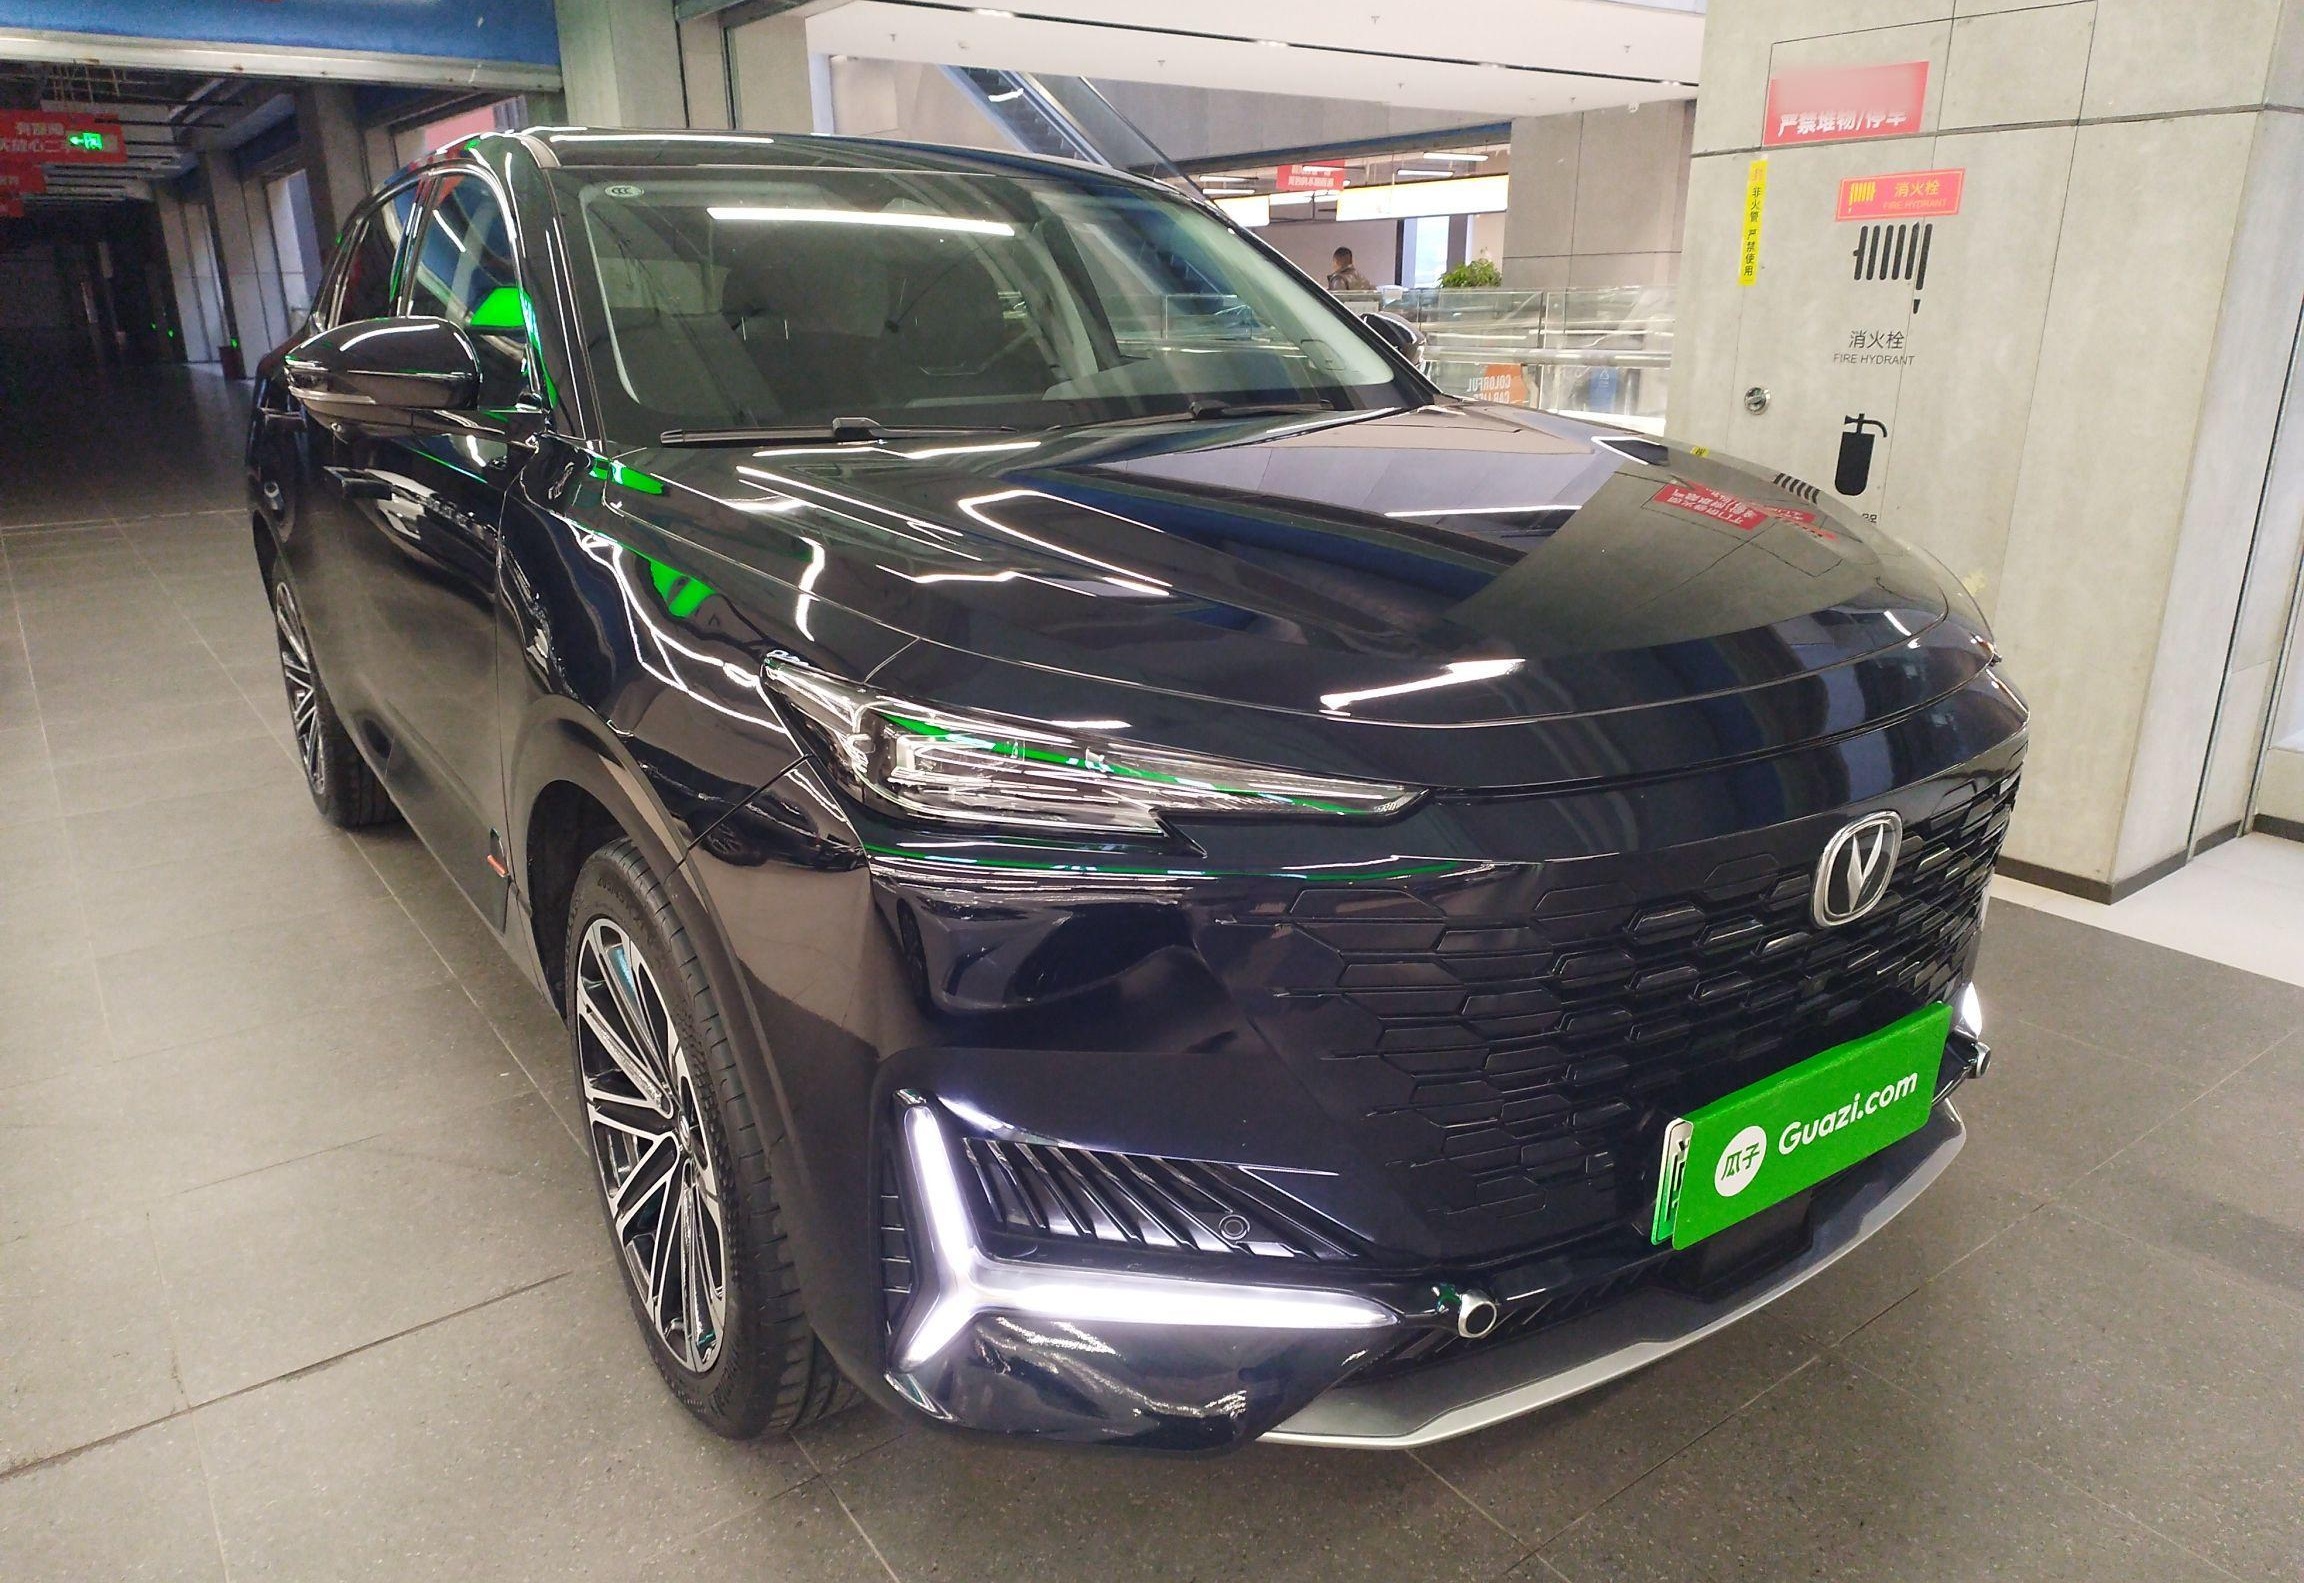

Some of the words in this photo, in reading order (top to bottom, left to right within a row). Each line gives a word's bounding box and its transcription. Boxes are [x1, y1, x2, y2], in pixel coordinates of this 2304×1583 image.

[1894, 180, 1939, 197] 消火栓
[1744, 229, 1757, 276] 严禁使用
[1848, 330, 1905, 349] 消火栓
[1833, 353, 1858, 364] FIRE
[1860, 354, 1915, 365] HYDRANT
[1720, 1142, 1761, 1181] 瓜子
[1778, 1072, 1918, 1156] Guazi.com
